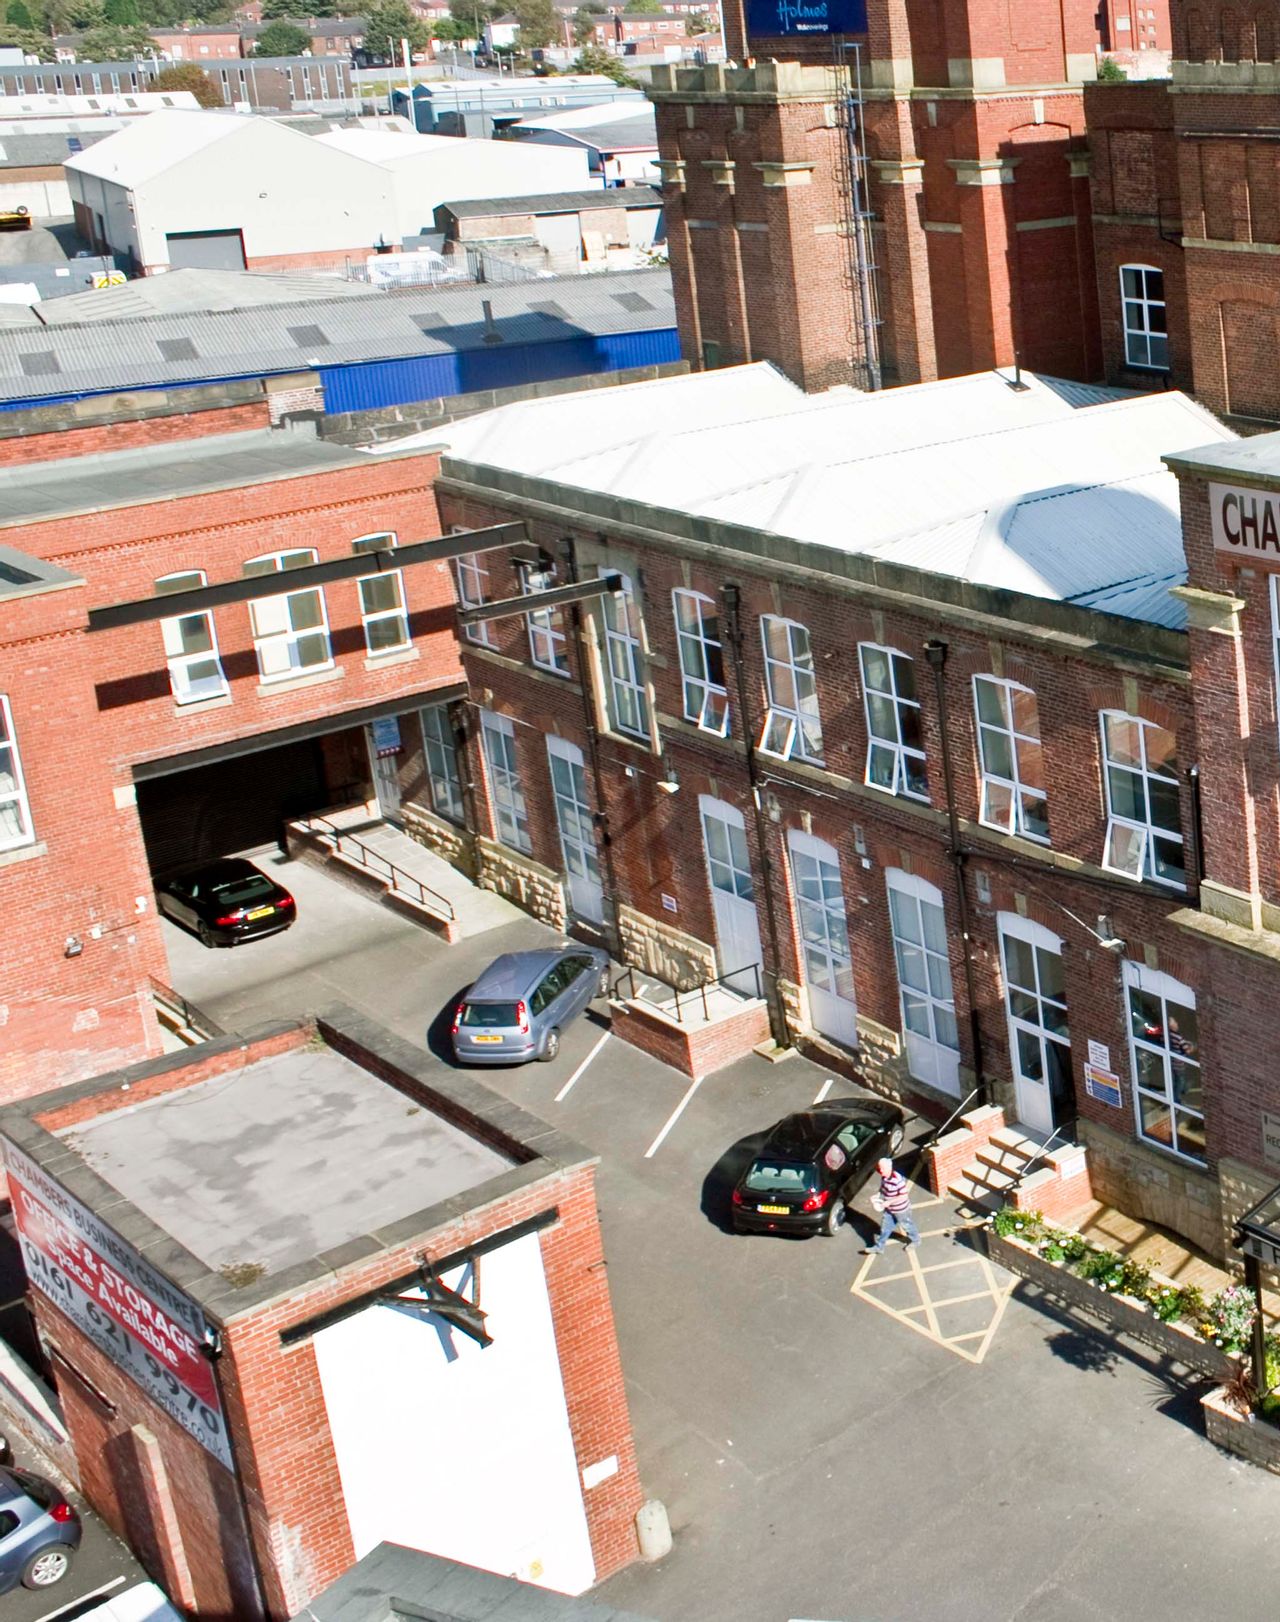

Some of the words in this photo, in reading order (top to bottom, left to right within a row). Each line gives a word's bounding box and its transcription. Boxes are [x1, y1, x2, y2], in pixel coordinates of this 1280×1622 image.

[776, 0, 828, 31] Holmes
[8, 1149, 73, 1222] CHAMBERS
[72, 1205, 136, 1278] BUSINESS
[134, 1260, 192, 1327] CENTRE
[19, 1188, 82, 1261] OFFICE
[82, 1245, 100, 1276] &
[99, 1260, 199, 1365] STORAGE
[45, 1232, 96, 1295] Space
[96, 1280, 180, 1369] Available
[24, 1240, 74, 1301] 0161
[84, 1298, 132, 1355] 621
[143, 1350, 221, 1438] 9970
